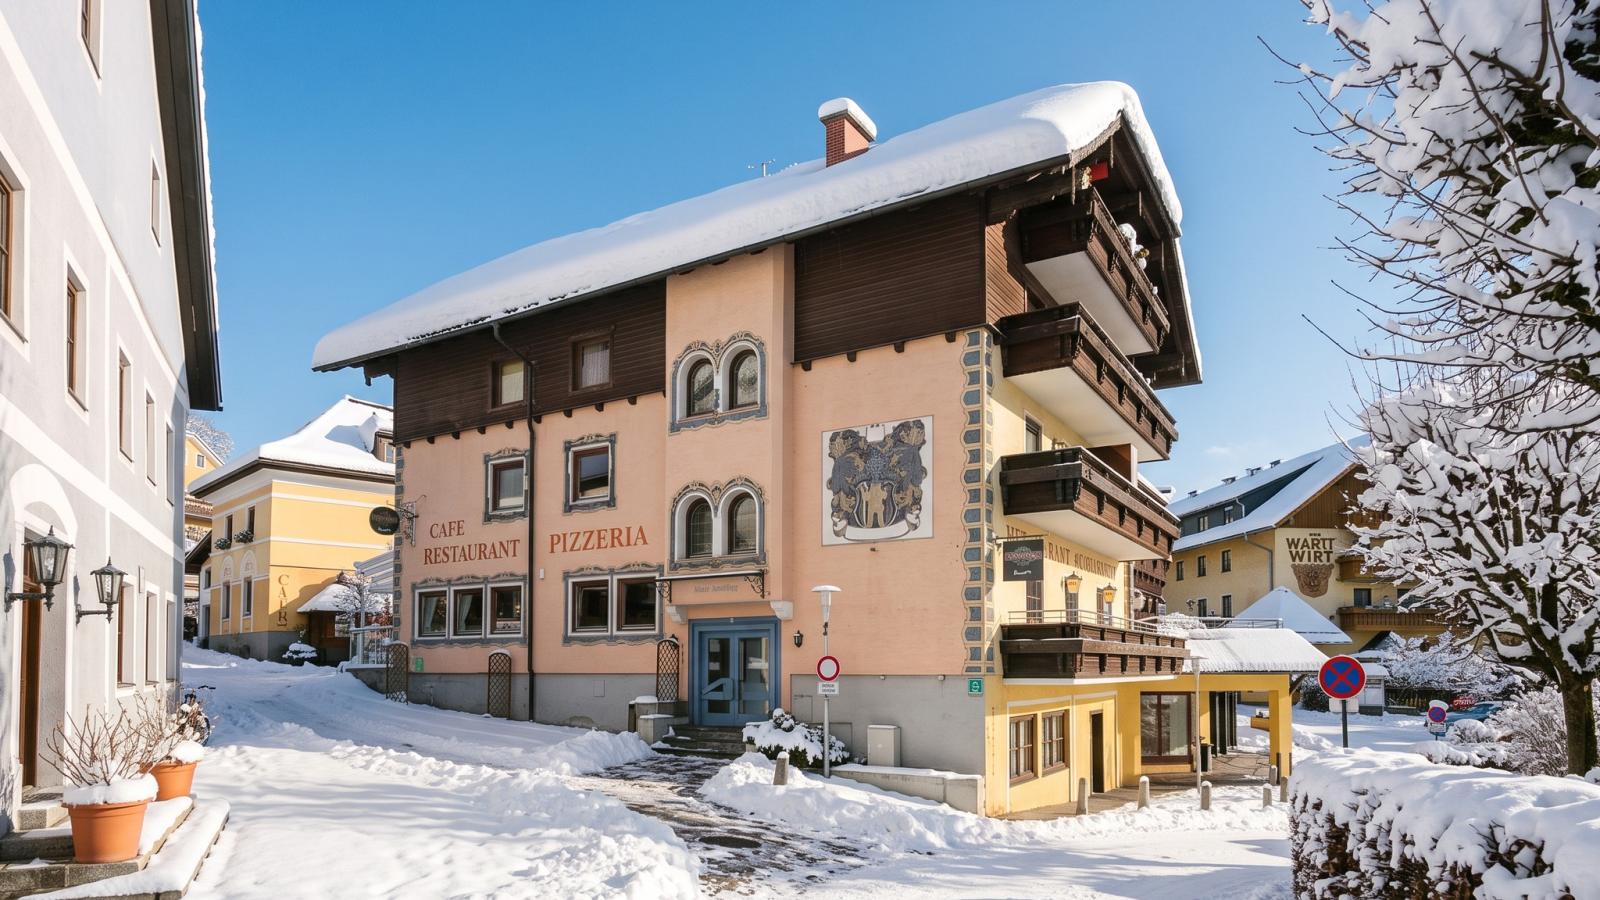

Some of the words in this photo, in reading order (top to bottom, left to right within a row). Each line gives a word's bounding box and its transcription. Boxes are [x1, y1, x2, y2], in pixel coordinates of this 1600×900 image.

[429, 519, 465, 539] CAFE
[549, 525, 649, 554] PIZZERIA
[423, 539, 521, 565] RESTAURANT
[1288, 550, 1334, 563] WIRT
